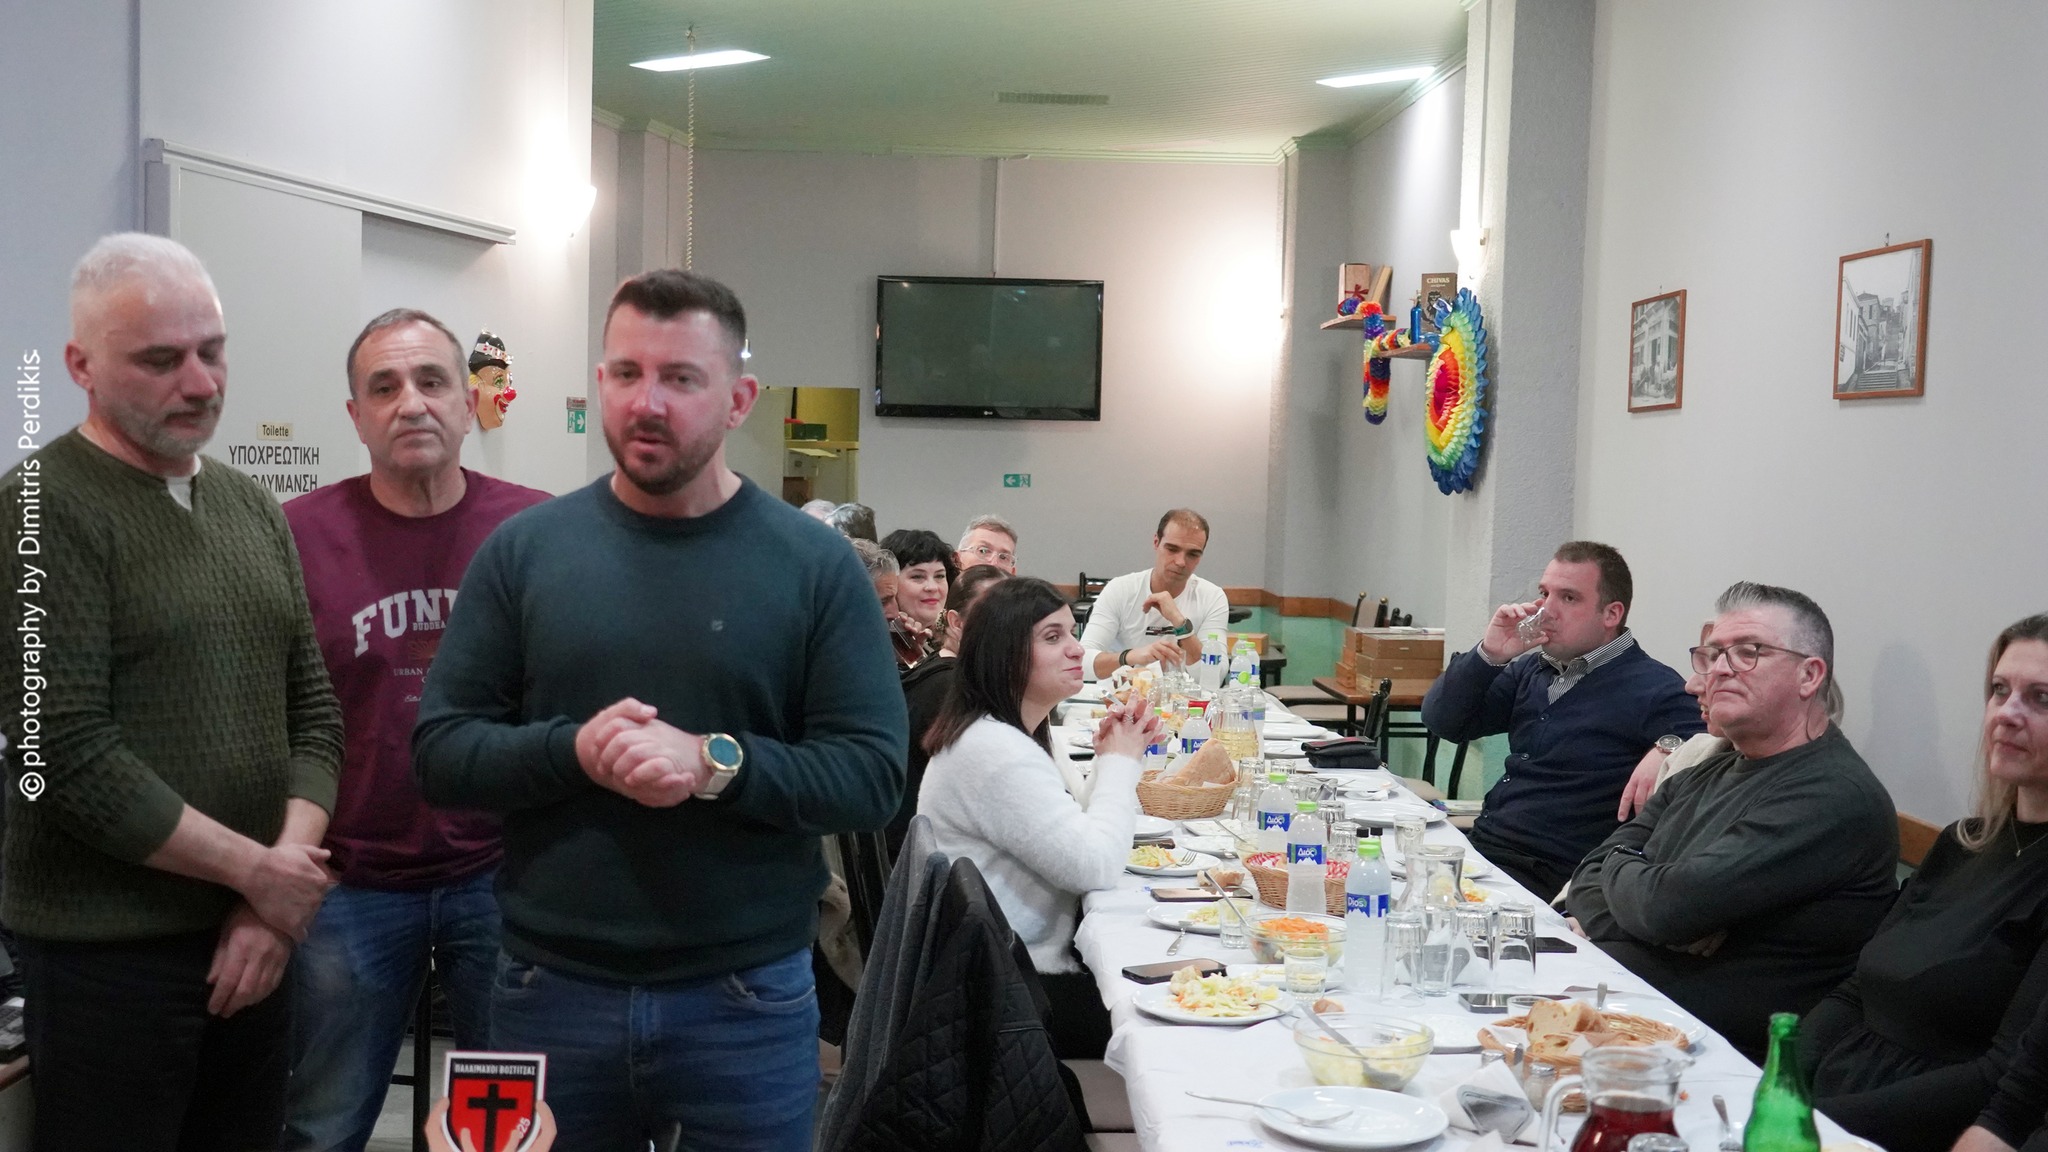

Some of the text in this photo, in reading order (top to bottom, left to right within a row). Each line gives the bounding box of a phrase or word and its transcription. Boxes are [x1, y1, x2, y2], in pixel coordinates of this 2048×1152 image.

[262, 424, 289, 437] Toilette
[228, 445, 320, 465] ΥΠΟΧΡΕΩΤΙΚΗ
[393, 667, 423, 676] URBAN
